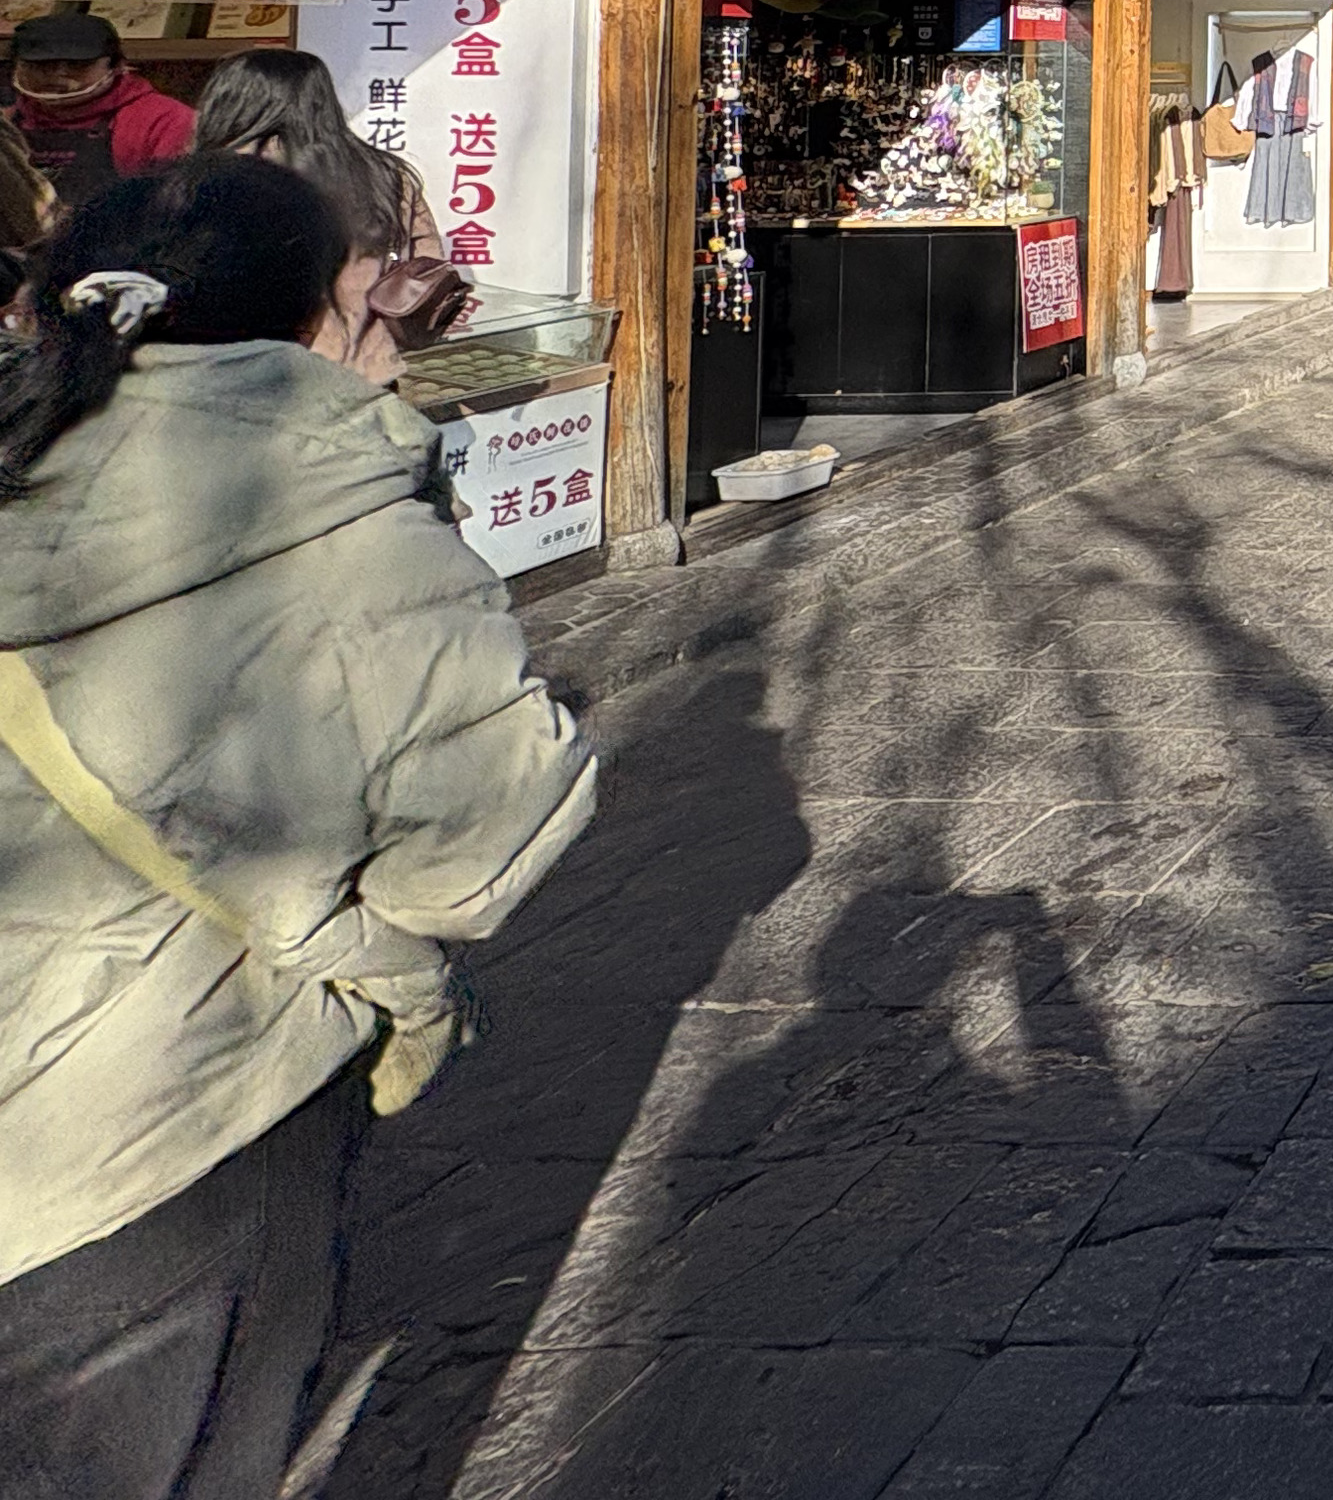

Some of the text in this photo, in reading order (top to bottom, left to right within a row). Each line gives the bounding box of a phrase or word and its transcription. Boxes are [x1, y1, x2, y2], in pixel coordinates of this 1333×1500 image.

[447, 112, 498, 266] 送5盒
[1024, 235, 1077, 279] 房租到期
[1026, 268, 1079, 311] 全场五折
[488, 468, 594, 531] 送5盒
